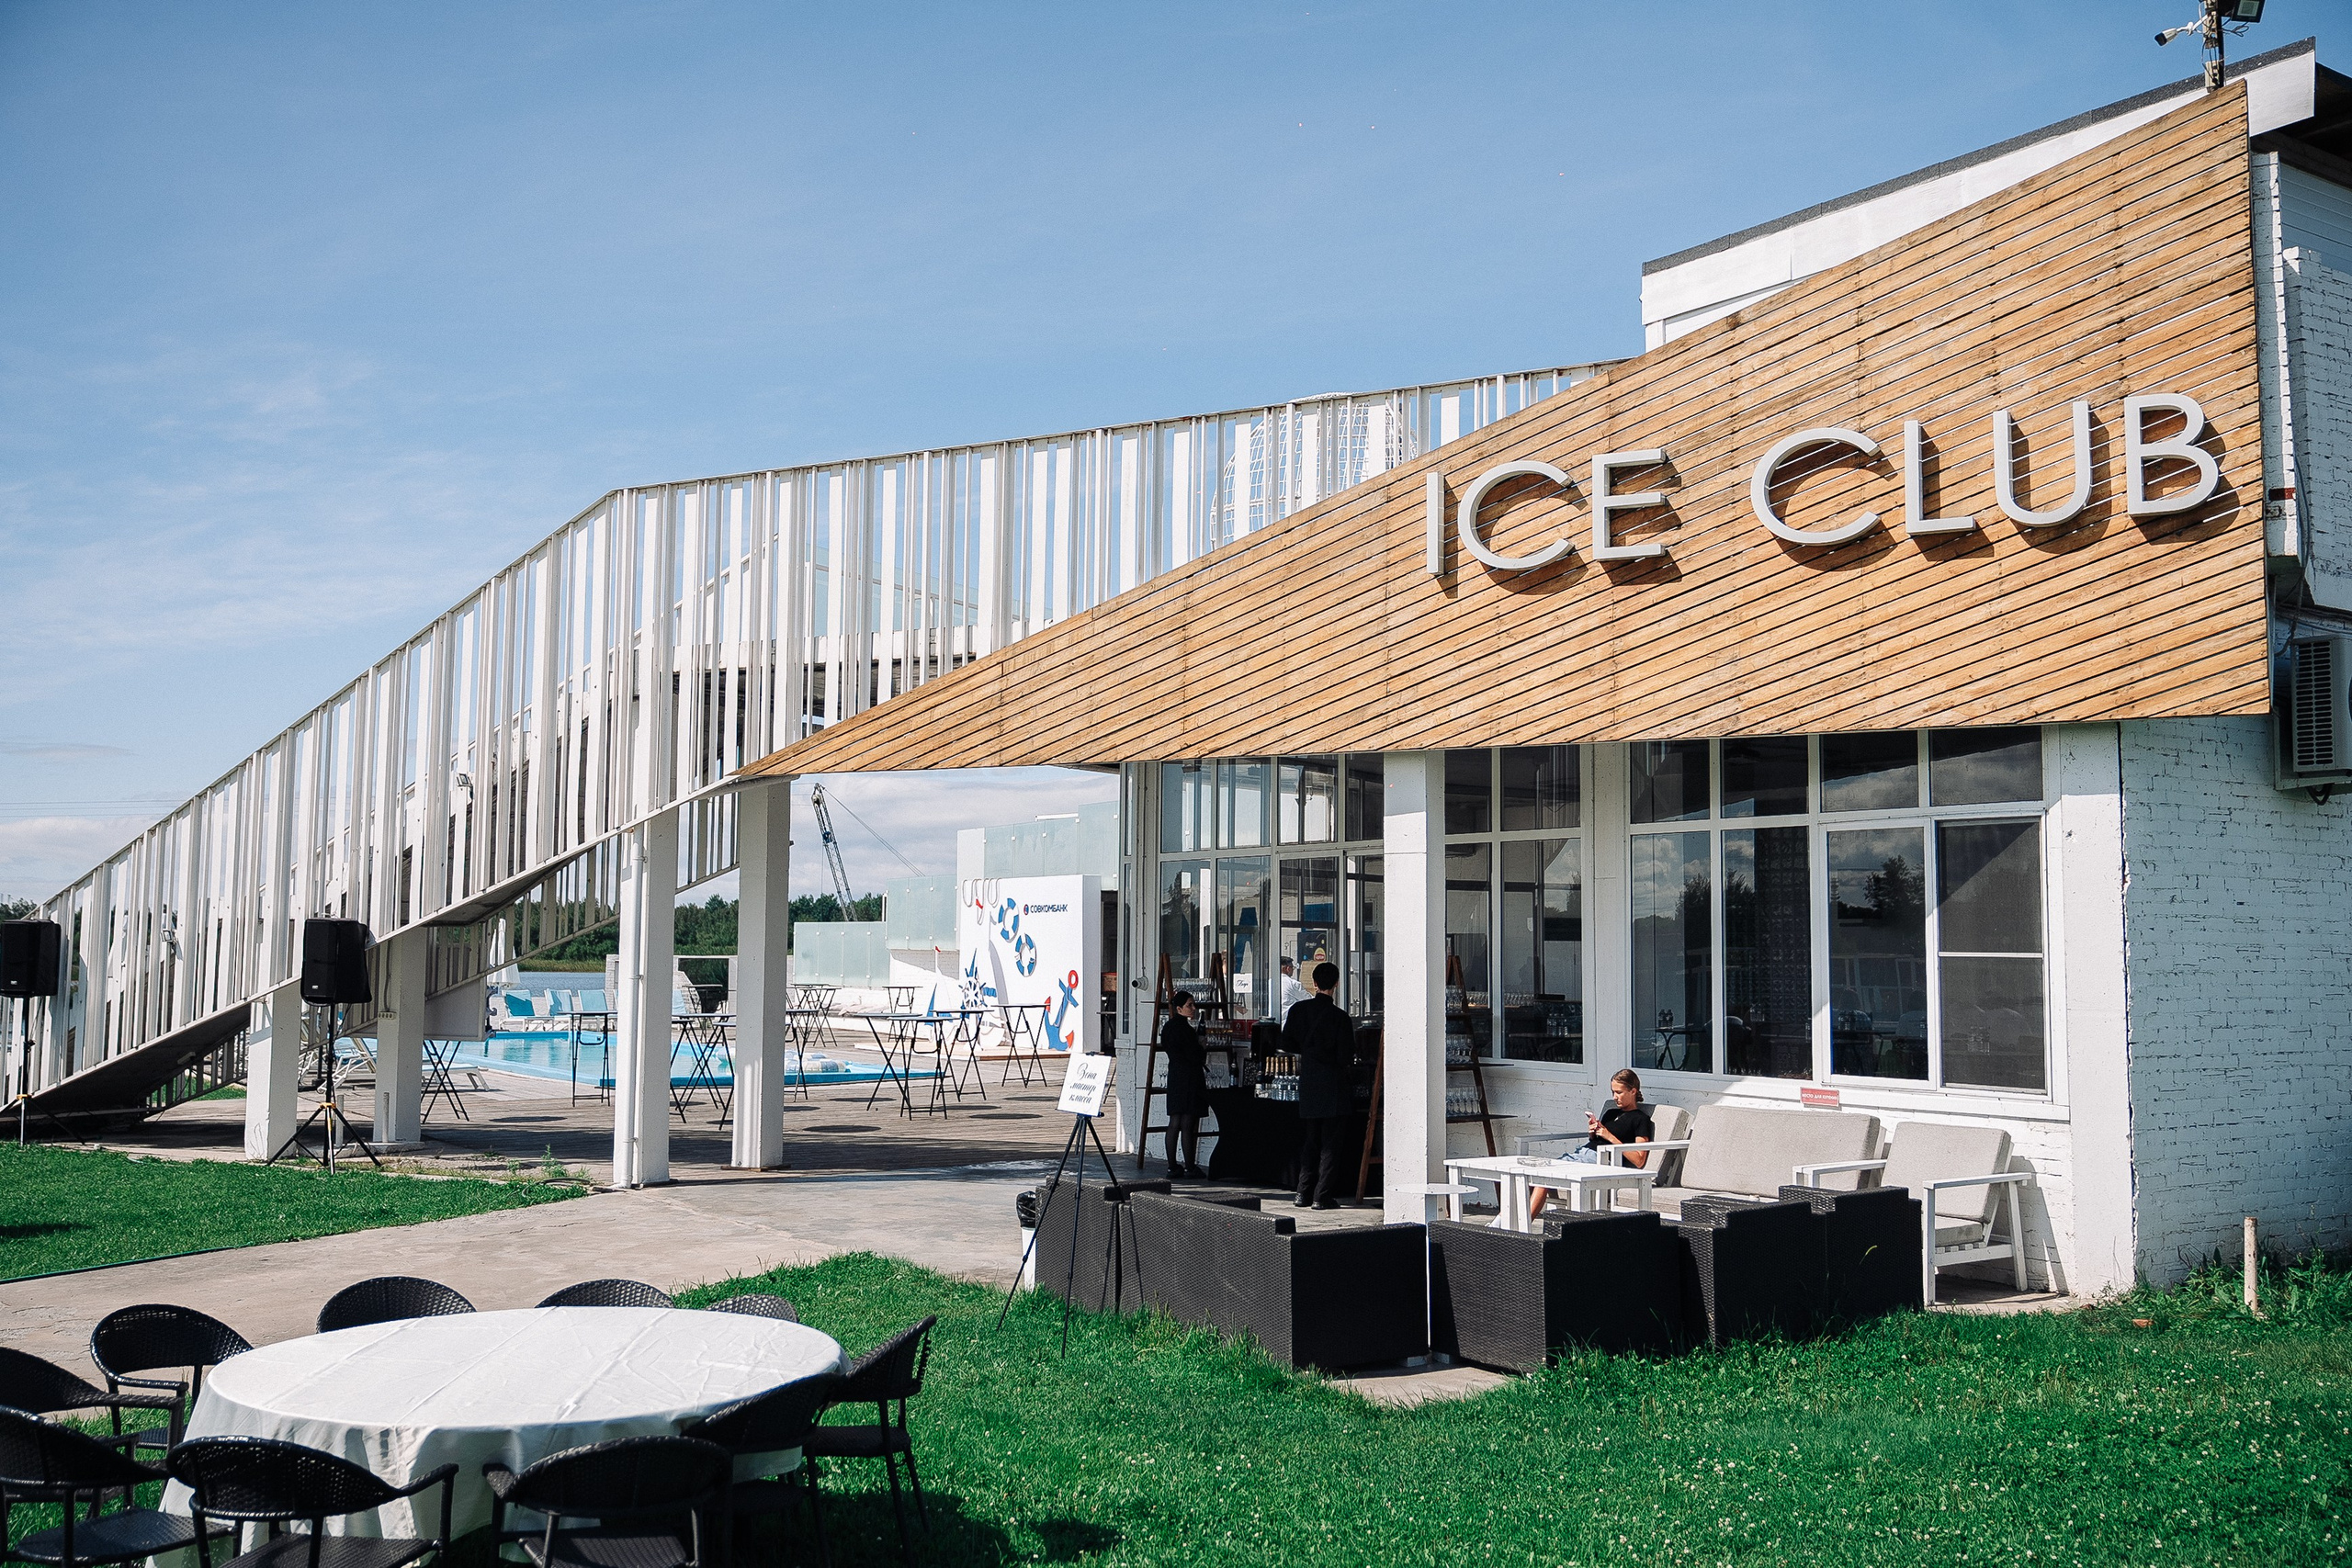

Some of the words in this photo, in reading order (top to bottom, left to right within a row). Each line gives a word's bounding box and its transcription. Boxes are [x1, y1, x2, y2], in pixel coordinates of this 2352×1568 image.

[1426, 447, 1668, 577] ICE
[1749, 393, 2221, 547] CLUB
[1030, 903, 1069, 913] СОВКОМБАНК
[1077, 1062, 1097, 1080] Зона
